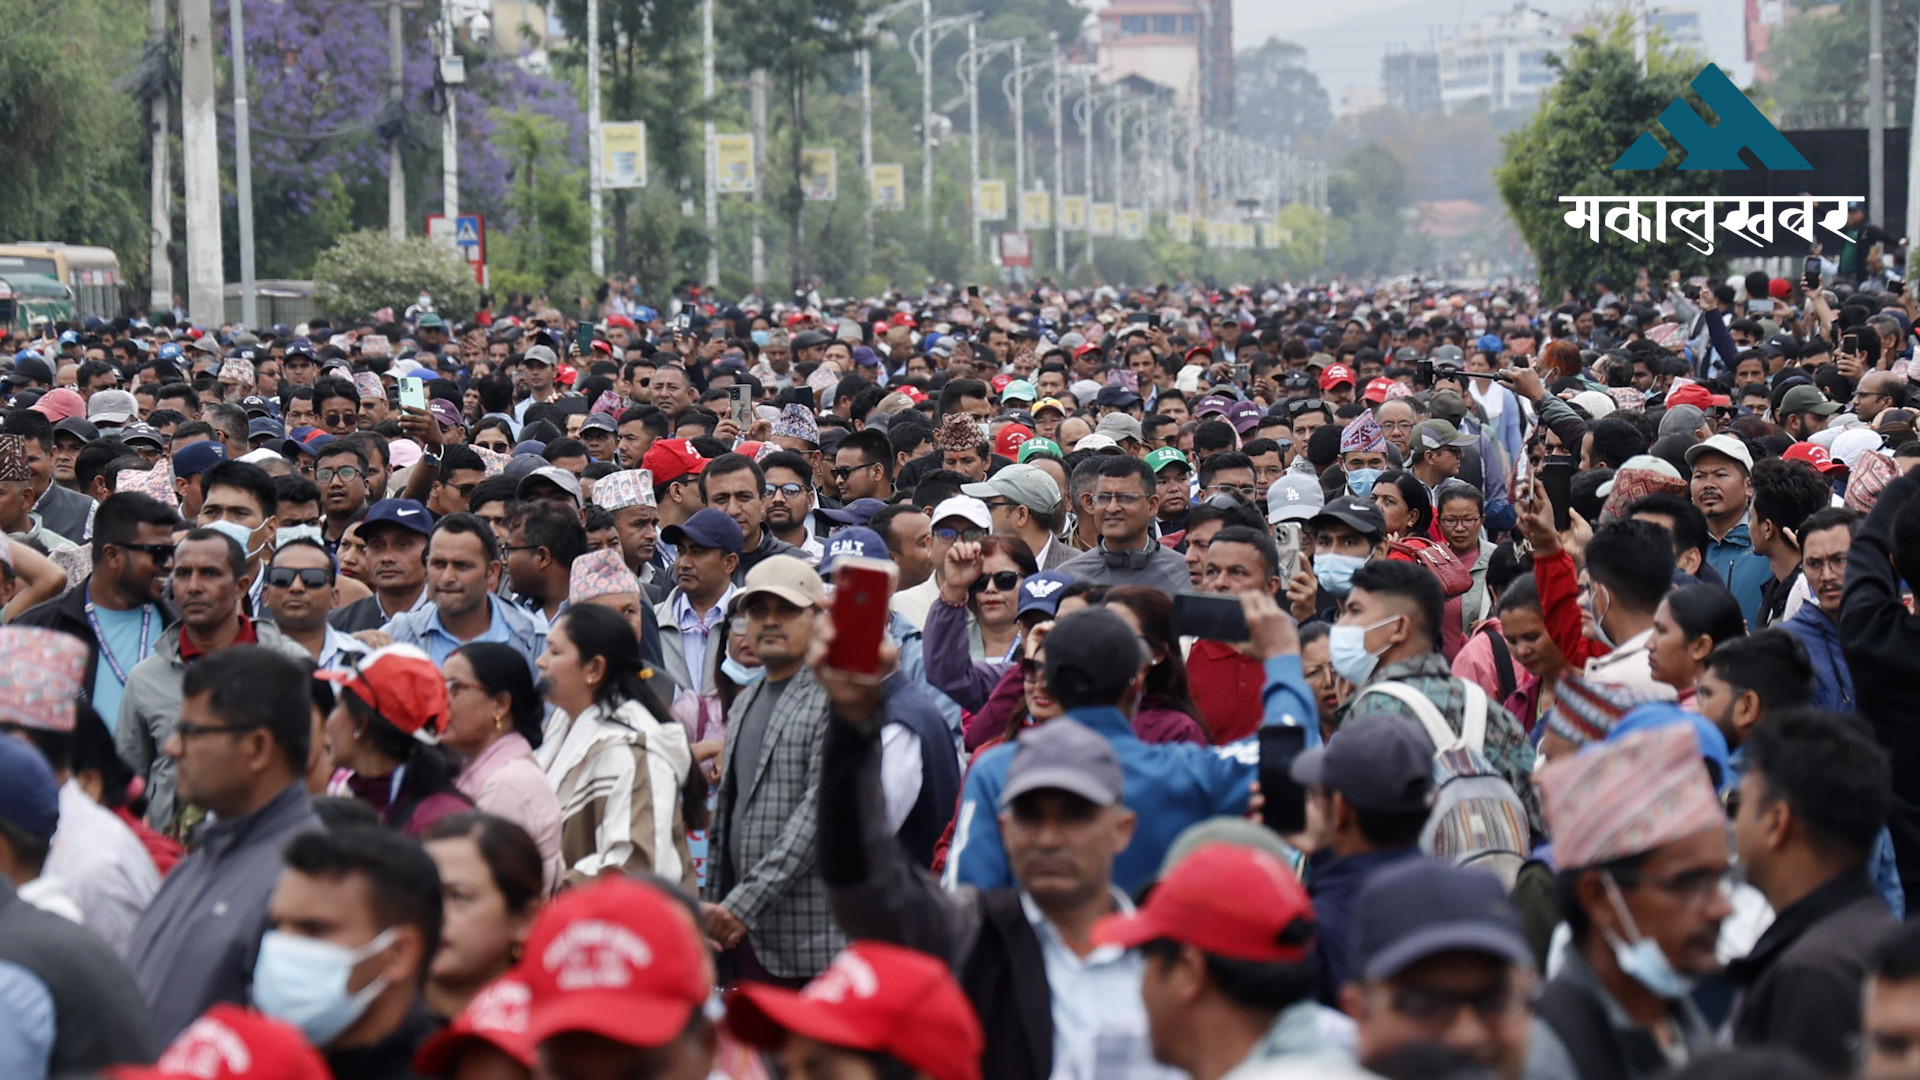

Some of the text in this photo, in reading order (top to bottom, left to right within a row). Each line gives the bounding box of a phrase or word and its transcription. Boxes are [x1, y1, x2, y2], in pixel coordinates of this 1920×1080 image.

[1157, 449, 1178, 457] CNT
[1286, 486, 1300, 501] LA
[830, 539, 865, 553] CNT
